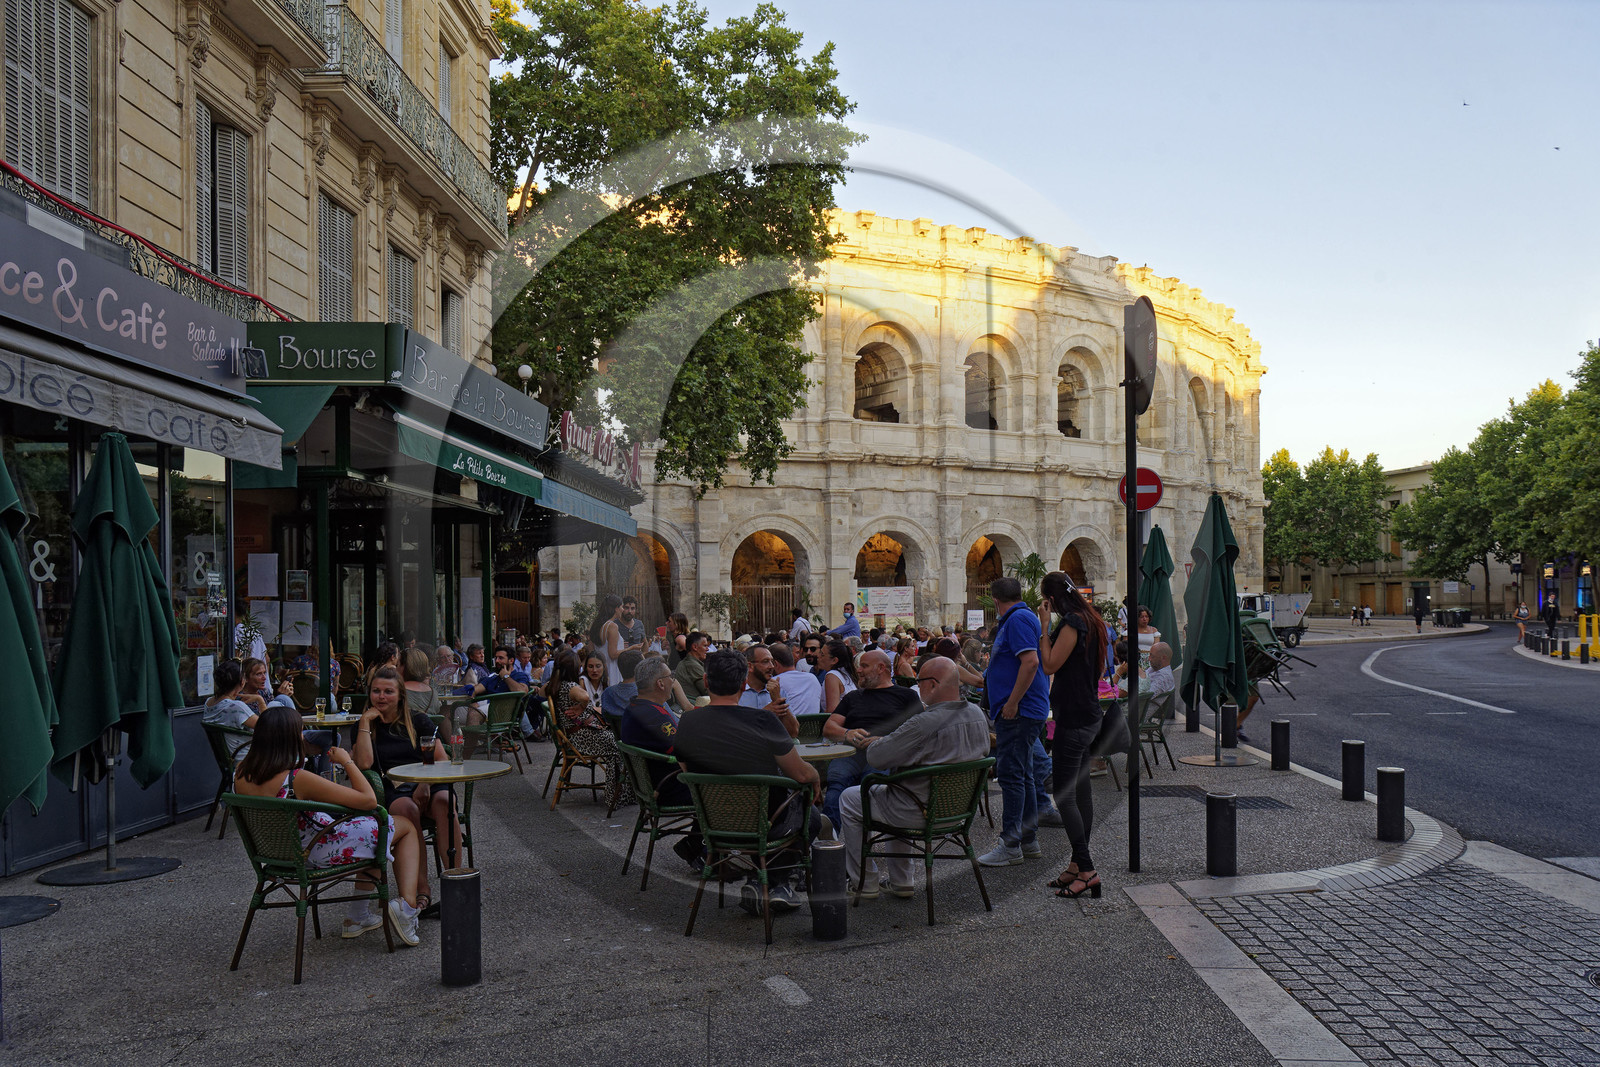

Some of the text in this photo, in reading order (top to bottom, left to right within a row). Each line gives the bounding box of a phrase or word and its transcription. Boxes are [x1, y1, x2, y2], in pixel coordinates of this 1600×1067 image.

[52, 257, 89, 330] &
[96, 287, 168, 350] Café
[187, 321, 217, 342] Bar à
[192, 341, 227, 361] Salade
[278, 335, 377, 370] Bourse
[410, 344, 542, 439] Bar de la Bourse
[147, 408, 229, 452] café
